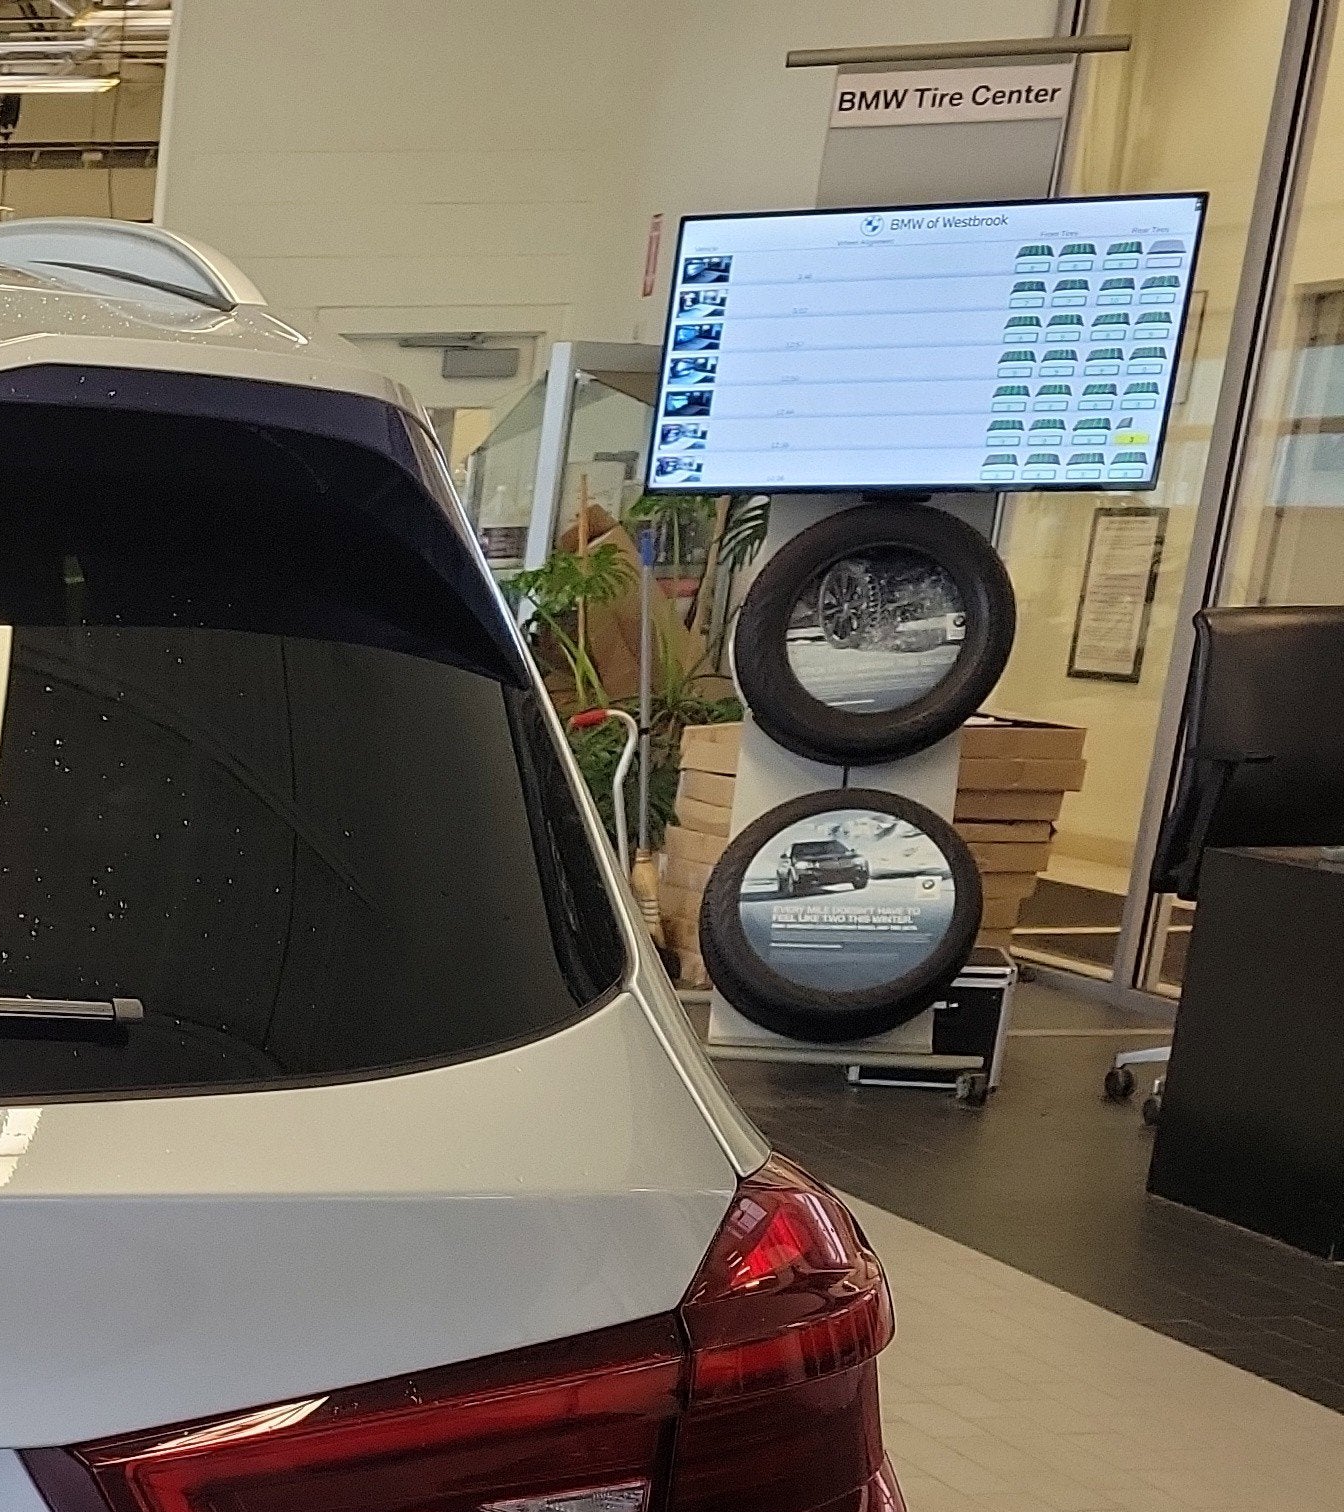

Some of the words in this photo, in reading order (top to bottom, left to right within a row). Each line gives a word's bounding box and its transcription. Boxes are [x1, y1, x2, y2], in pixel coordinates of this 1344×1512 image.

[838, 88, 908, 111] BMW
[913, 87, 963, 108] Tire
[971, 84, 1061, 106] Center
[890, 218, 924, 230] BMW
[927, 217, 940, 229] of
[942, 214, 1009, 228] Westbrook
[807, 906, 829, 915] MILE
[906, 907, 921, 916] TO
[773, 914, 796, 922] FEEL
[798, 914, 820, 922] LIKE
[823, 915, 846, 923] TWO
